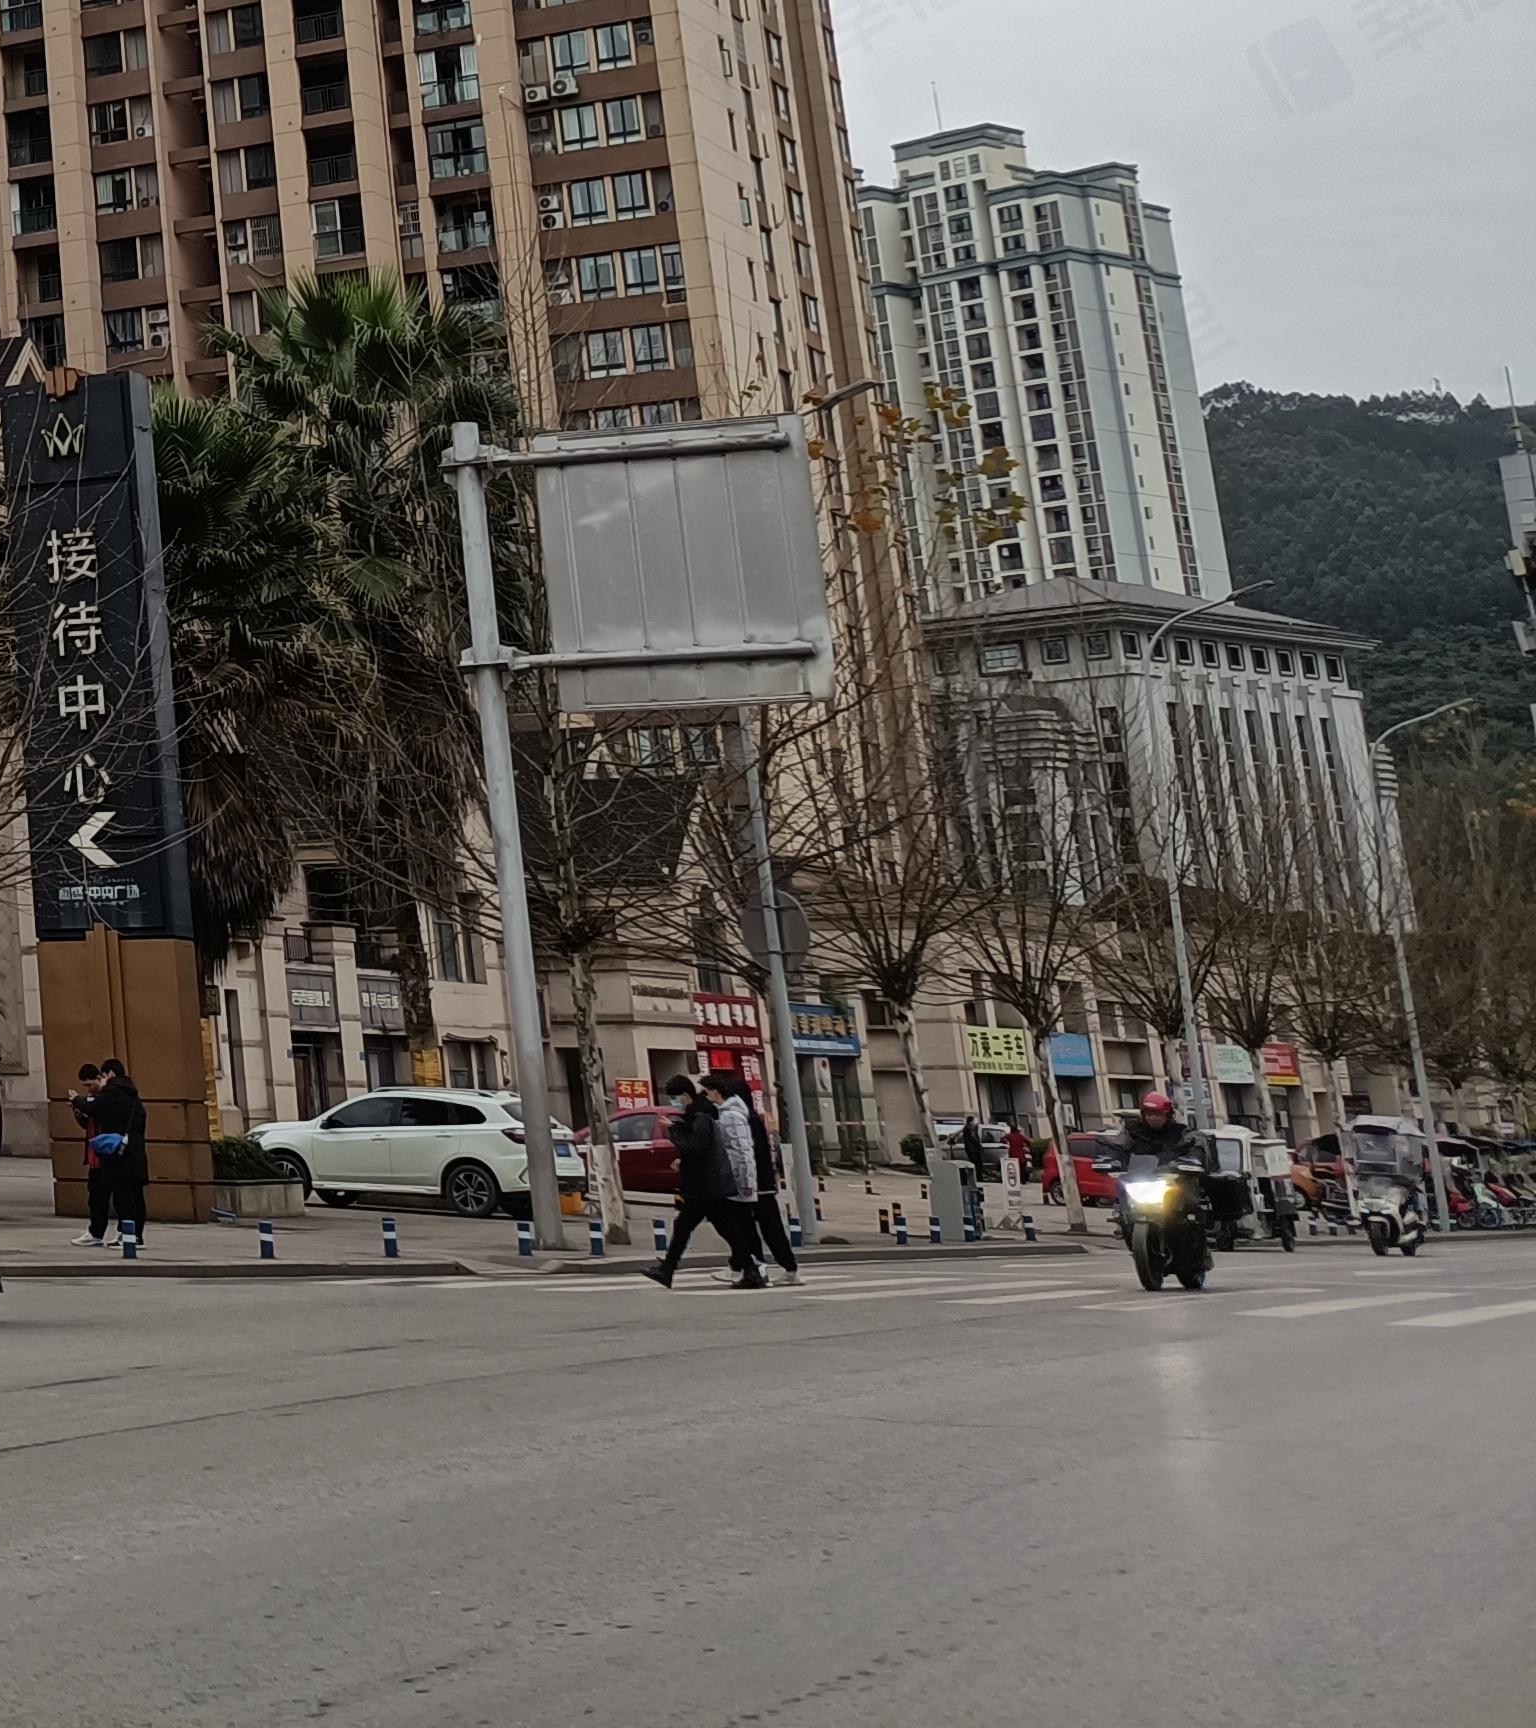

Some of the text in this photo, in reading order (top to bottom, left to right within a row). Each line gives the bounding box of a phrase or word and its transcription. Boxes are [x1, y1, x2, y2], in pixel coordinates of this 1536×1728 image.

[43, 527, 112, 807] 接待中心
[618, 1081, 648, 1095] 石头
